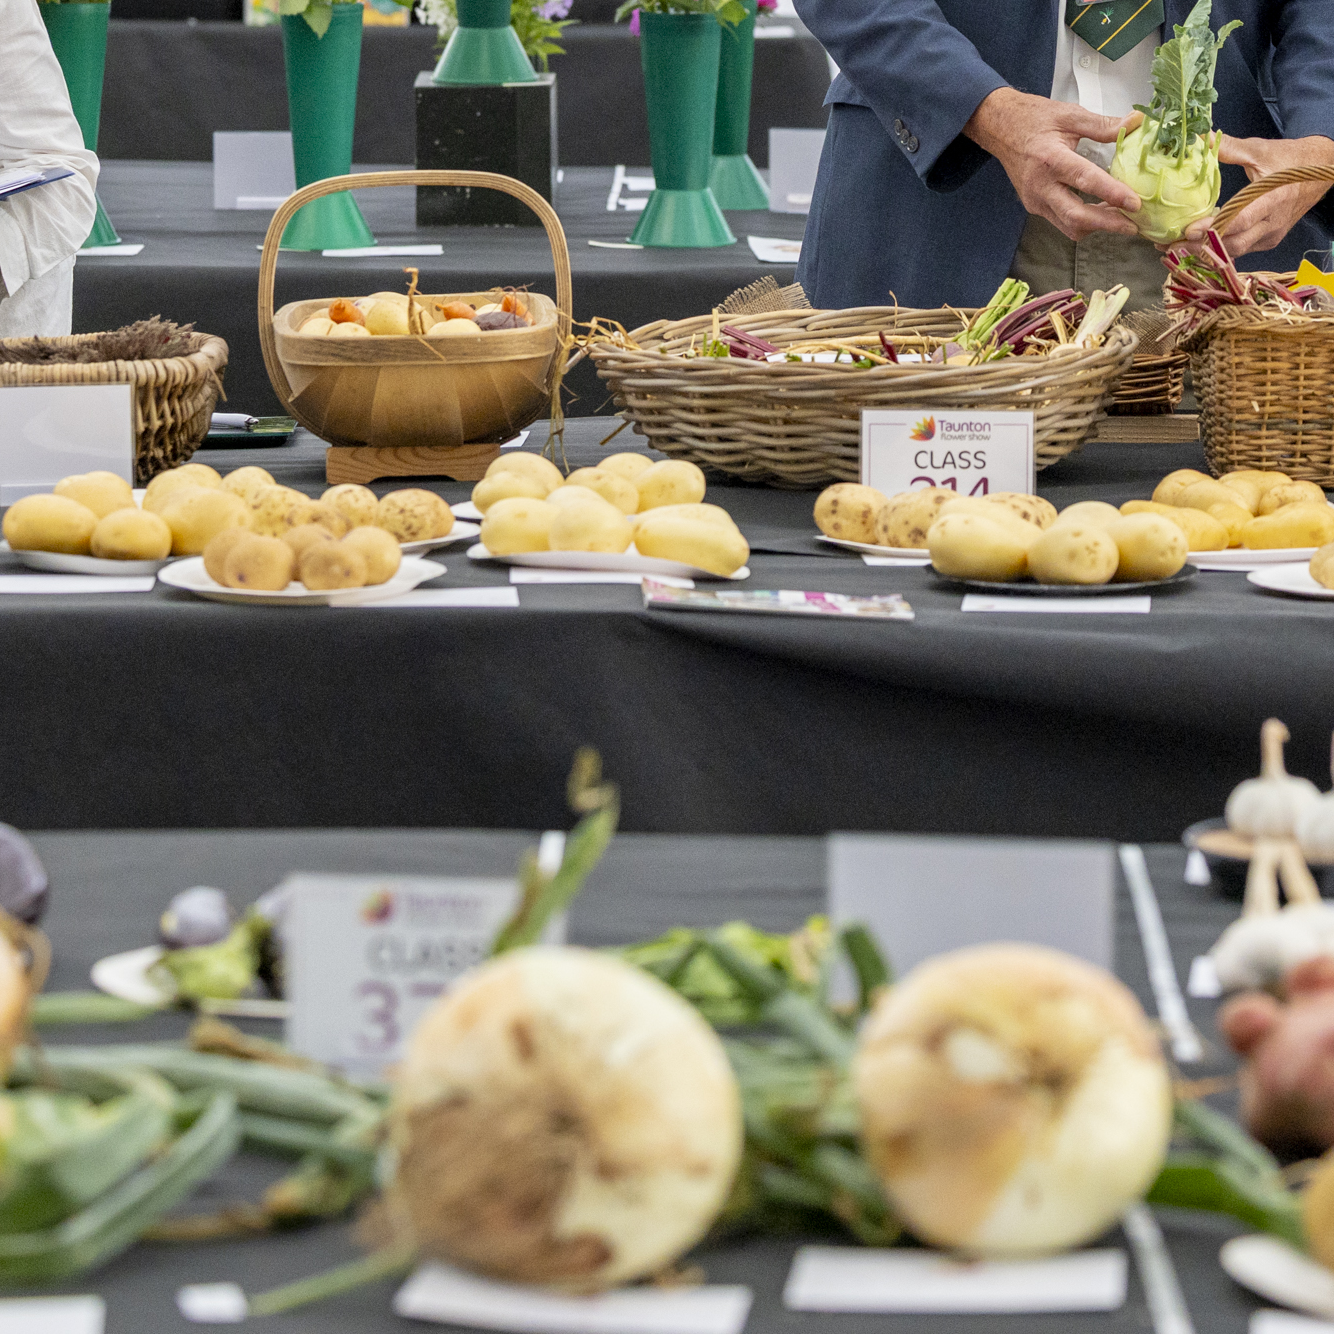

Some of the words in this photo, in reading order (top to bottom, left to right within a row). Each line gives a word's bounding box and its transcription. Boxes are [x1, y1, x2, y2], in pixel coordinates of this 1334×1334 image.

[938, 420, 991, 432] Taunton
[940, 432, 967, 441] flower
[968, 433, 991, 441] show
[914, 450, 987, 470] CLASS
